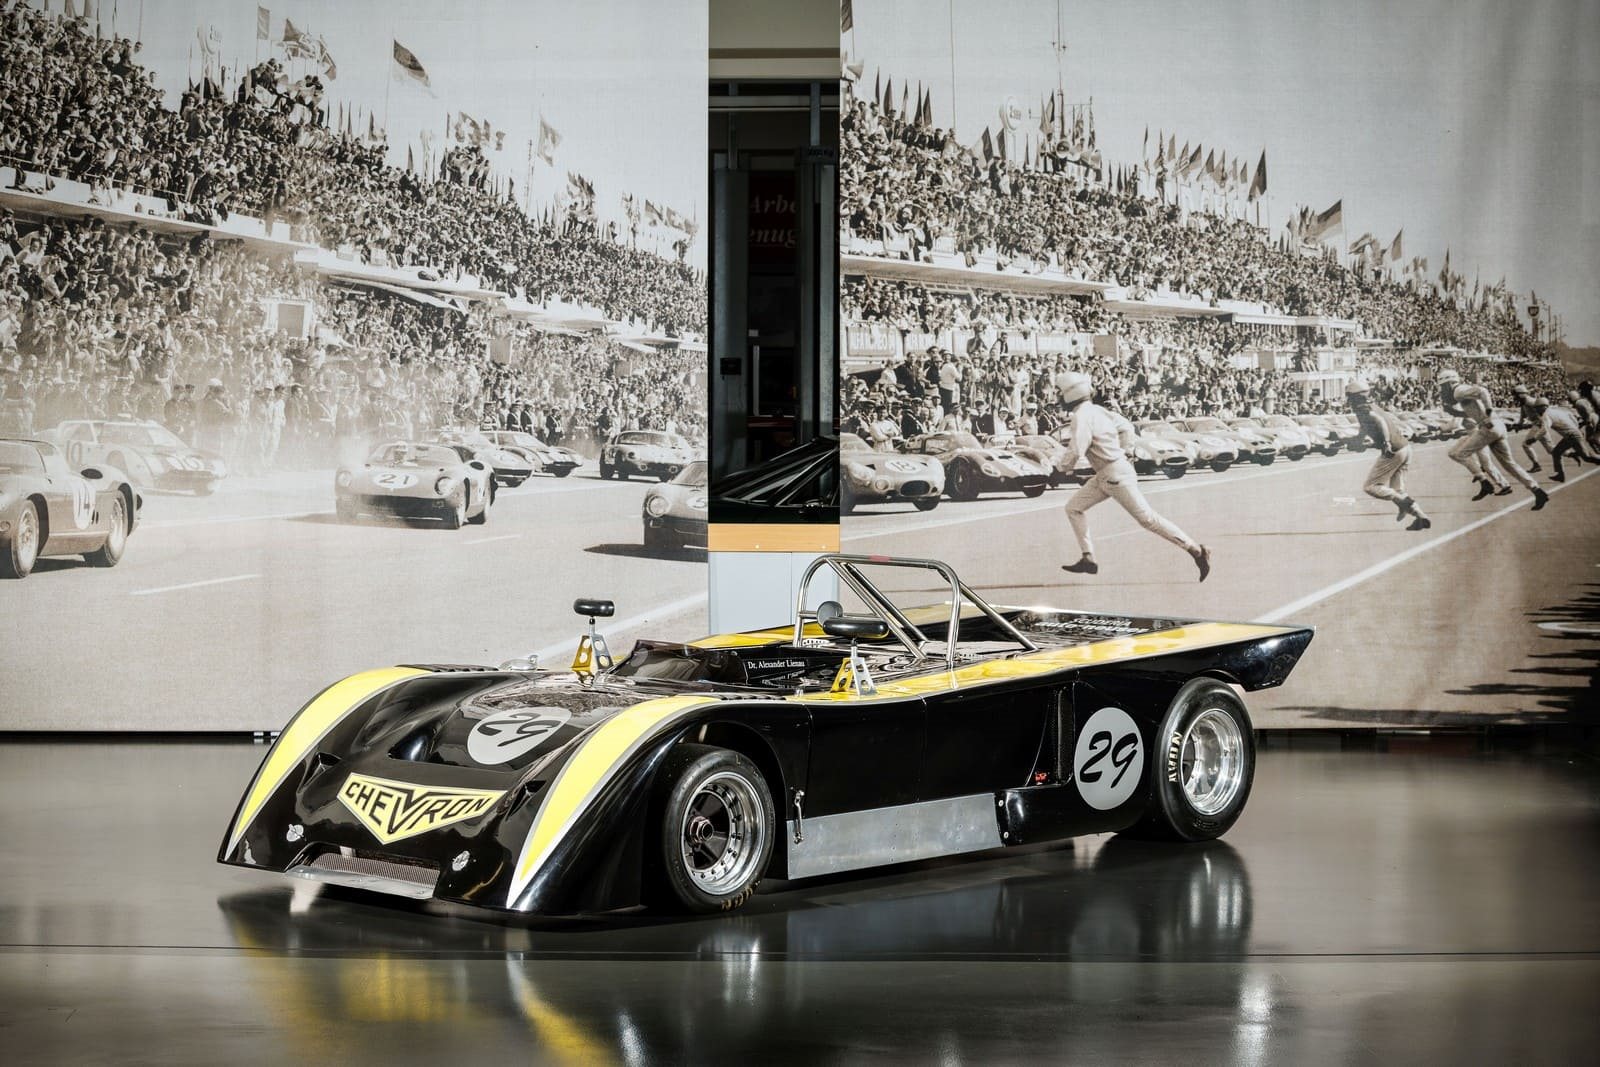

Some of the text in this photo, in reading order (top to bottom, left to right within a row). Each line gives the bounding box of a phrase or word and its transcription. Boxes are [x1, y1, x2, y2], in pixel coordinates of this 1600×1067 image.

[378, 473, 410, 485] 21
[758, 660, 785, 669] Alexander
[477, 712, 562, 747] 29
[1079, 730, 1139, 789] 29
[1168, 731, 1183, 783] AVON
[344, 779, 495, 835] CHEVRON
